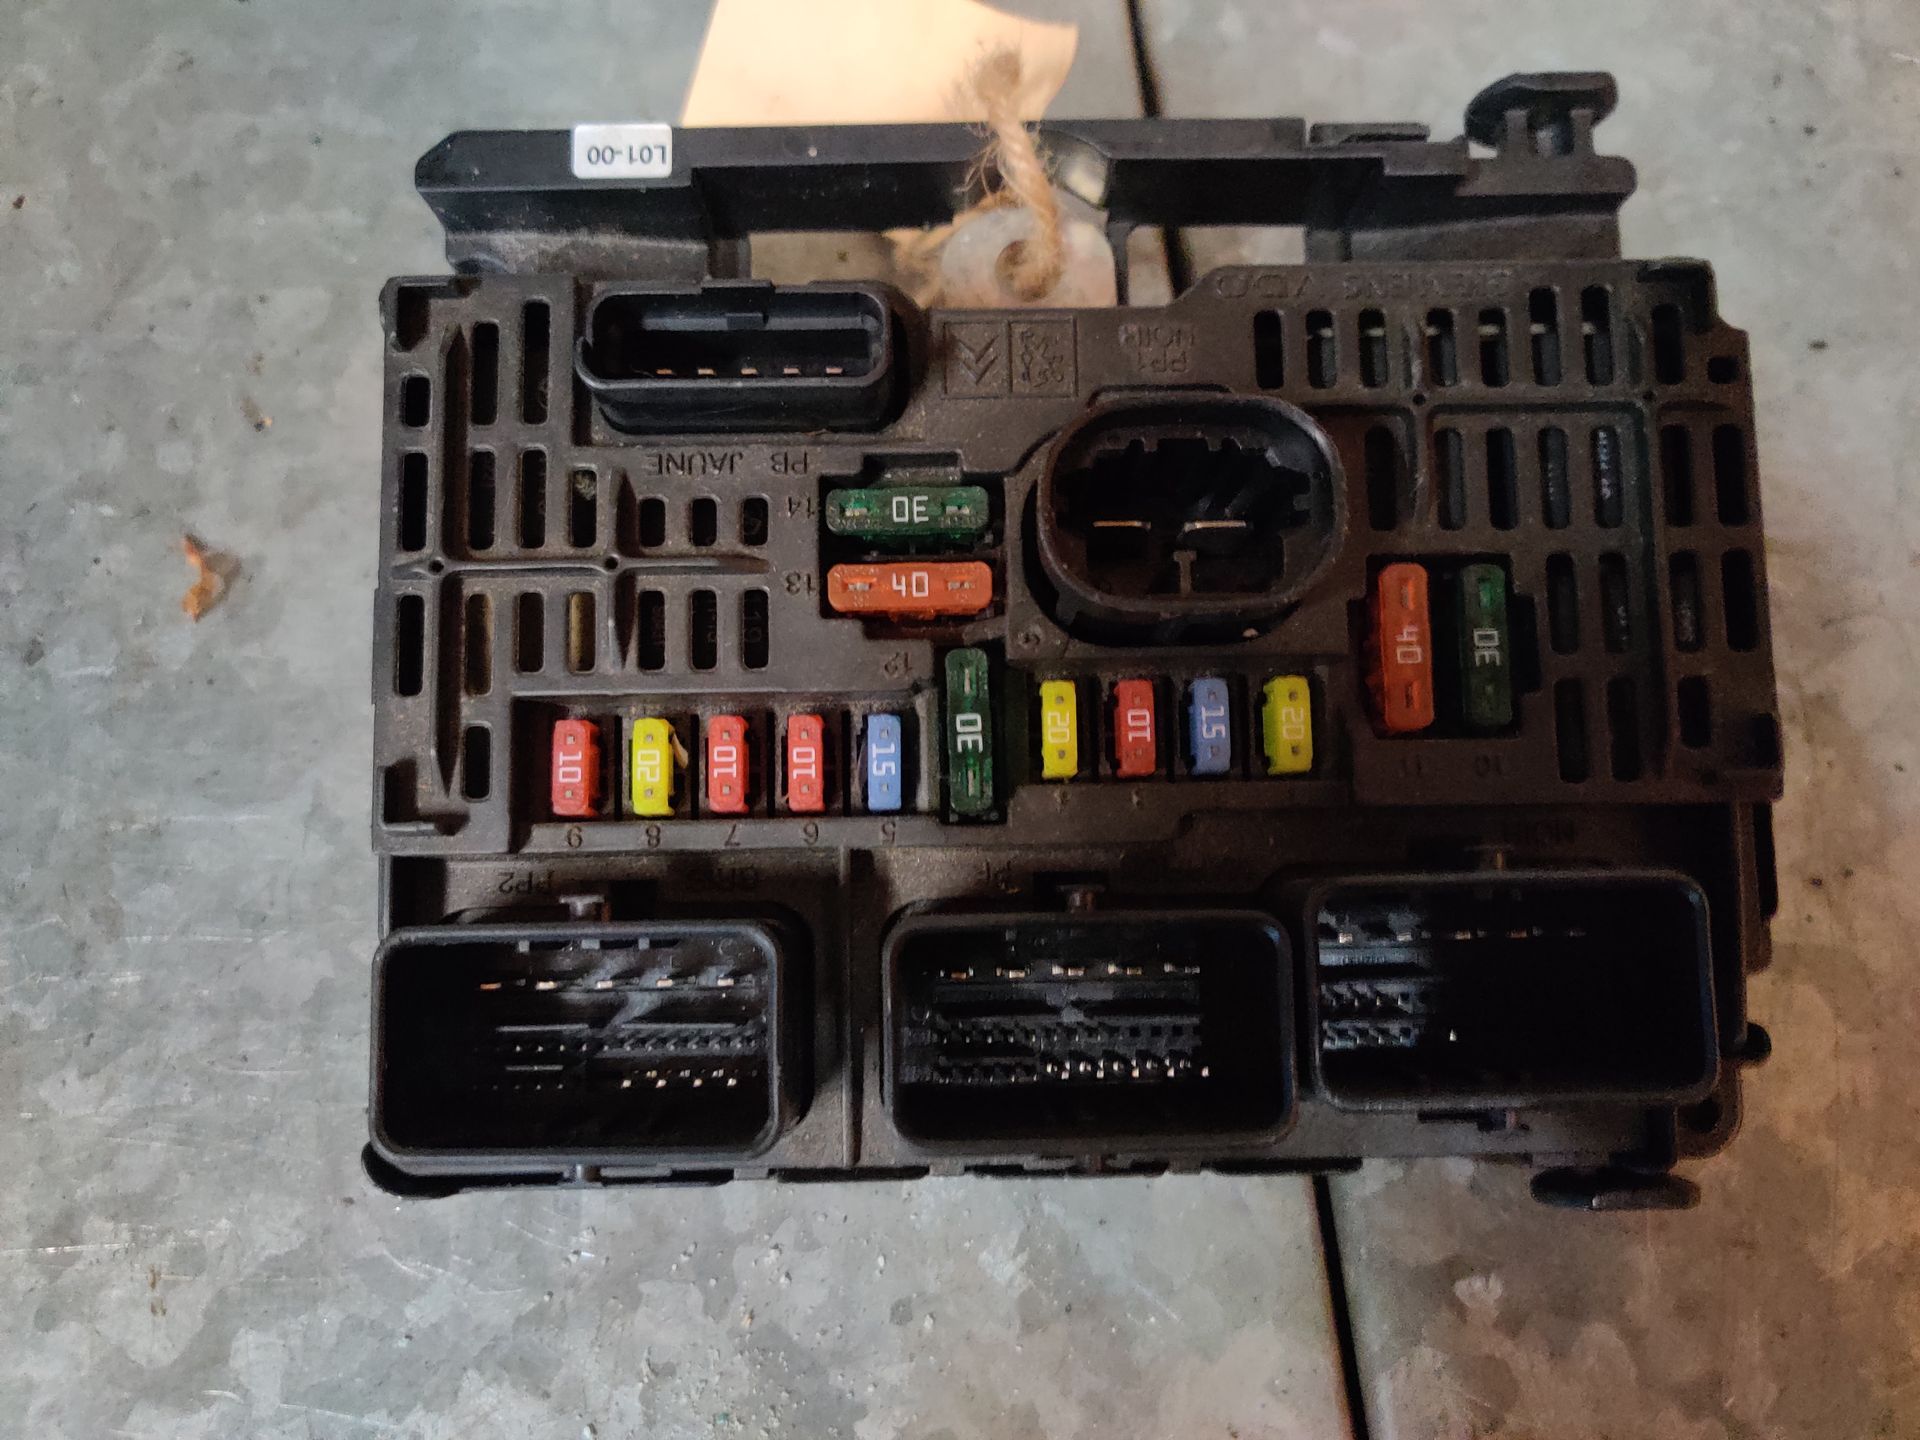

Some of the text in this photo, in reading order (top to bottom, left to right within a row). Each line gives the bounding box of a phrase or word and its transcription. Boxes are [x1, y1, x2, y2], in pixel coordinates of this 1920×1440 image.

[587, 147, 667, 166] L01-00
[645, 451, 809, 476] PB JAUNE
[785, 497, 816, 519] 14
[785, 573, 816, 595] 13
[891, 571, 929, 599] 40
[1396, 623, 1423, 665] 40
[1046, 710, 1071, 744] 20
[1127, 708, 1152, 743] 10
[1200, 705, 1226, 740] 15
[1281, 706, 1305, 741] 20
[558, 750, 582, 783] 10
[636, 748, 661, 783] 20
[713, 745, 737, 779] 10
[792, 745, 816, 780] 10
[871, 743, 897, 777] 15
[566, 825, 584, 849] 9
[644, 824, 663, 848] 8
[723, 825, 742, 848] 7
[801, 822, 820, 846] 6
[880, 821, 896, 845] 5
